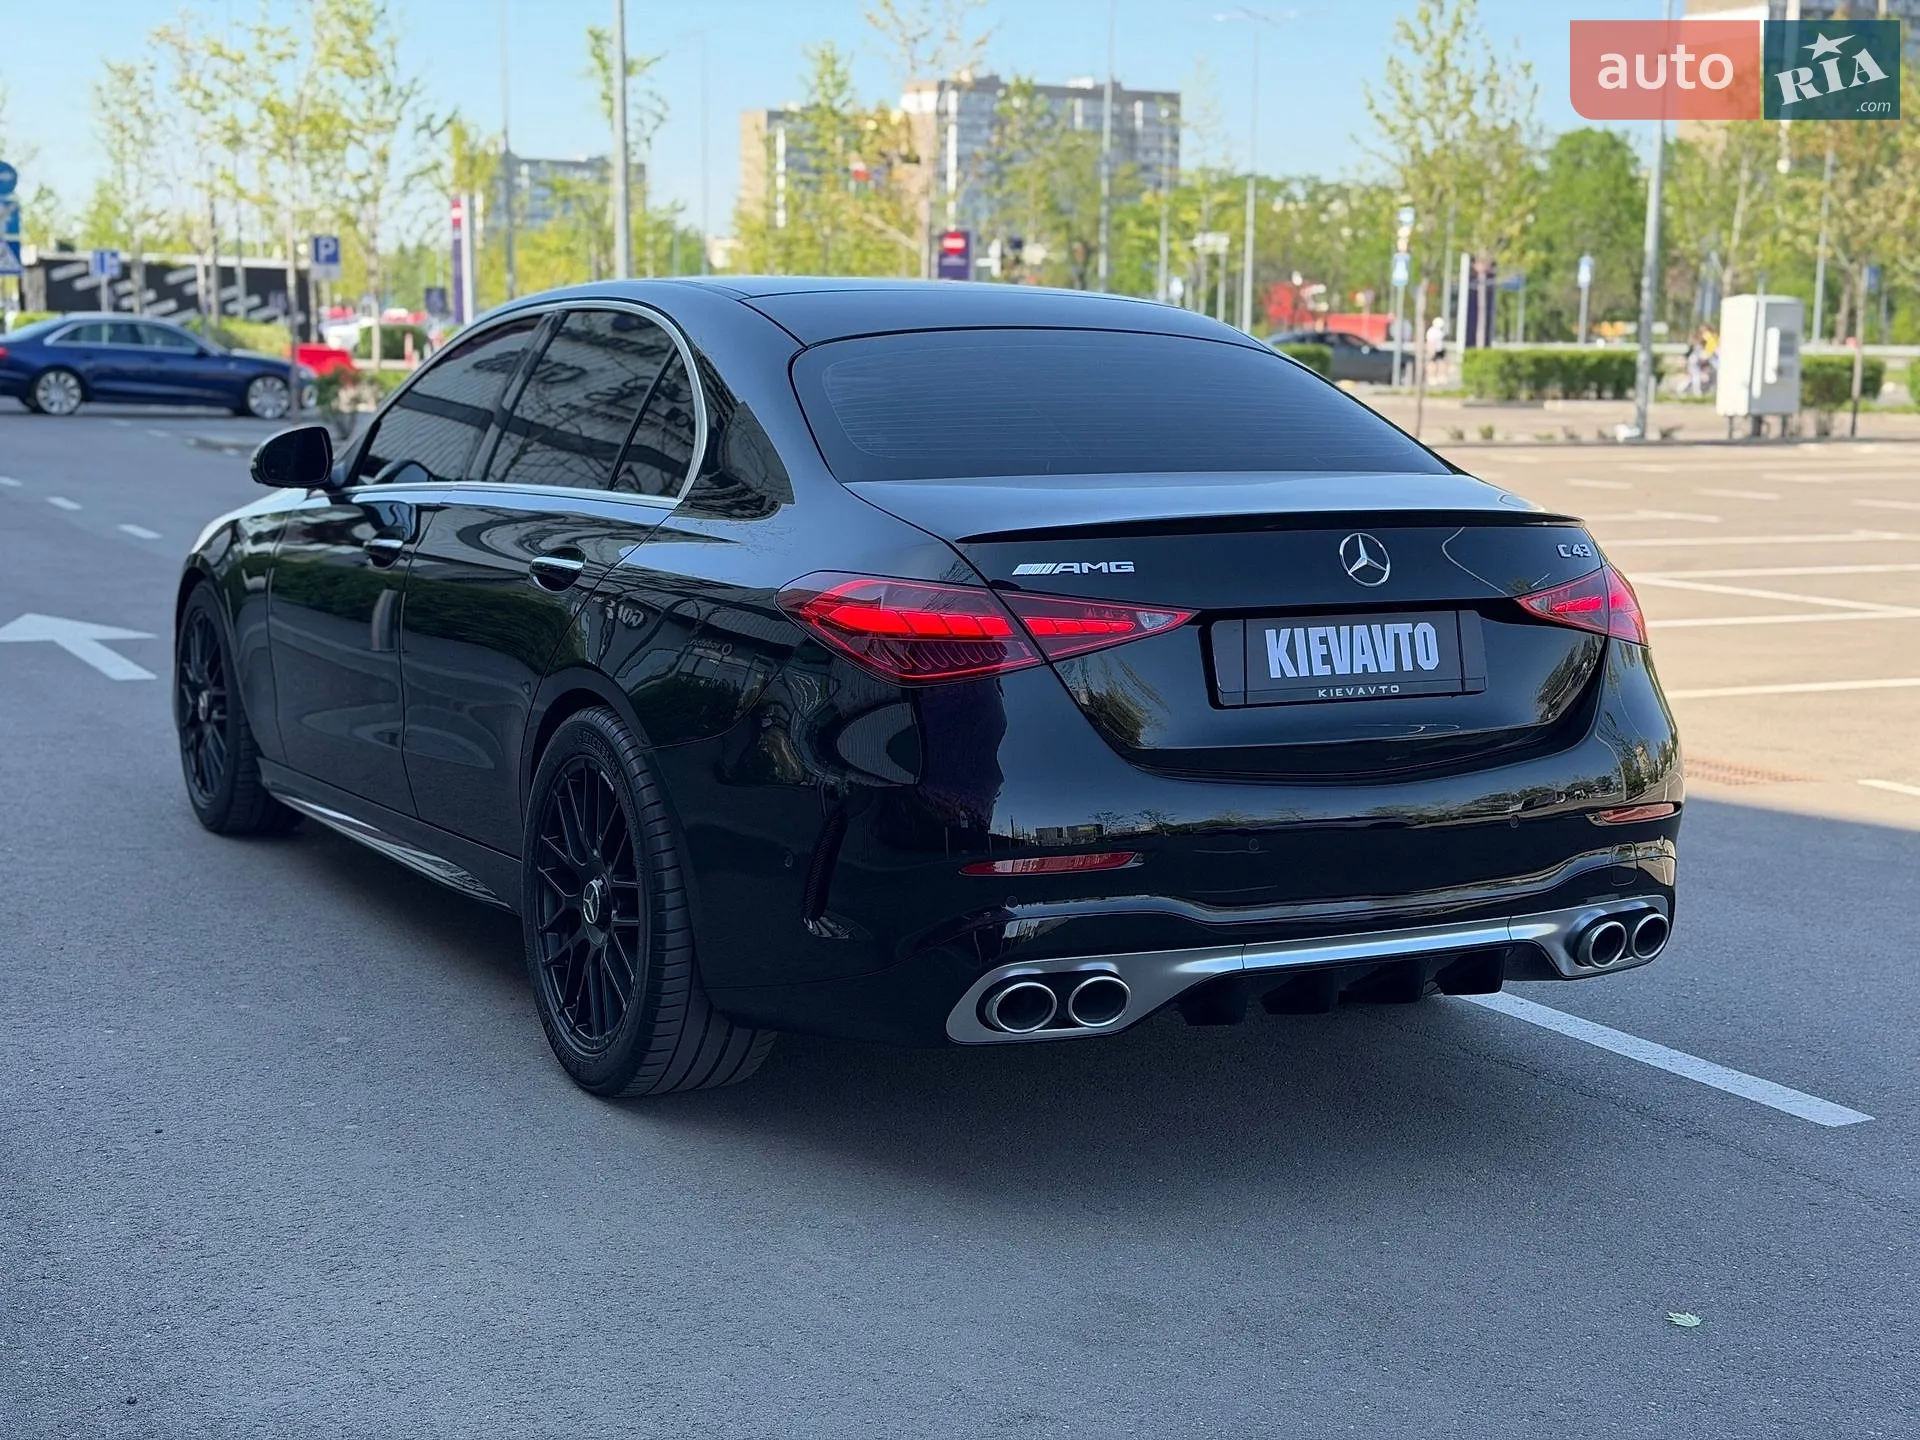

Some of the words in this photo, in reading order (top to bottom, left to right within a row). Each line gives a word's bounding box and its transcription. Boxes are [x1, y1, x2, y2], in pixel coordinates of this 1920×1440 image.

[318, 238, 336, 262] P
[1052, 561, 1135, 575] AMG
[1265, 622, 1440, 679] KIEVAVTO
[1318, 685, 1400, 698] KIEVAVTO
